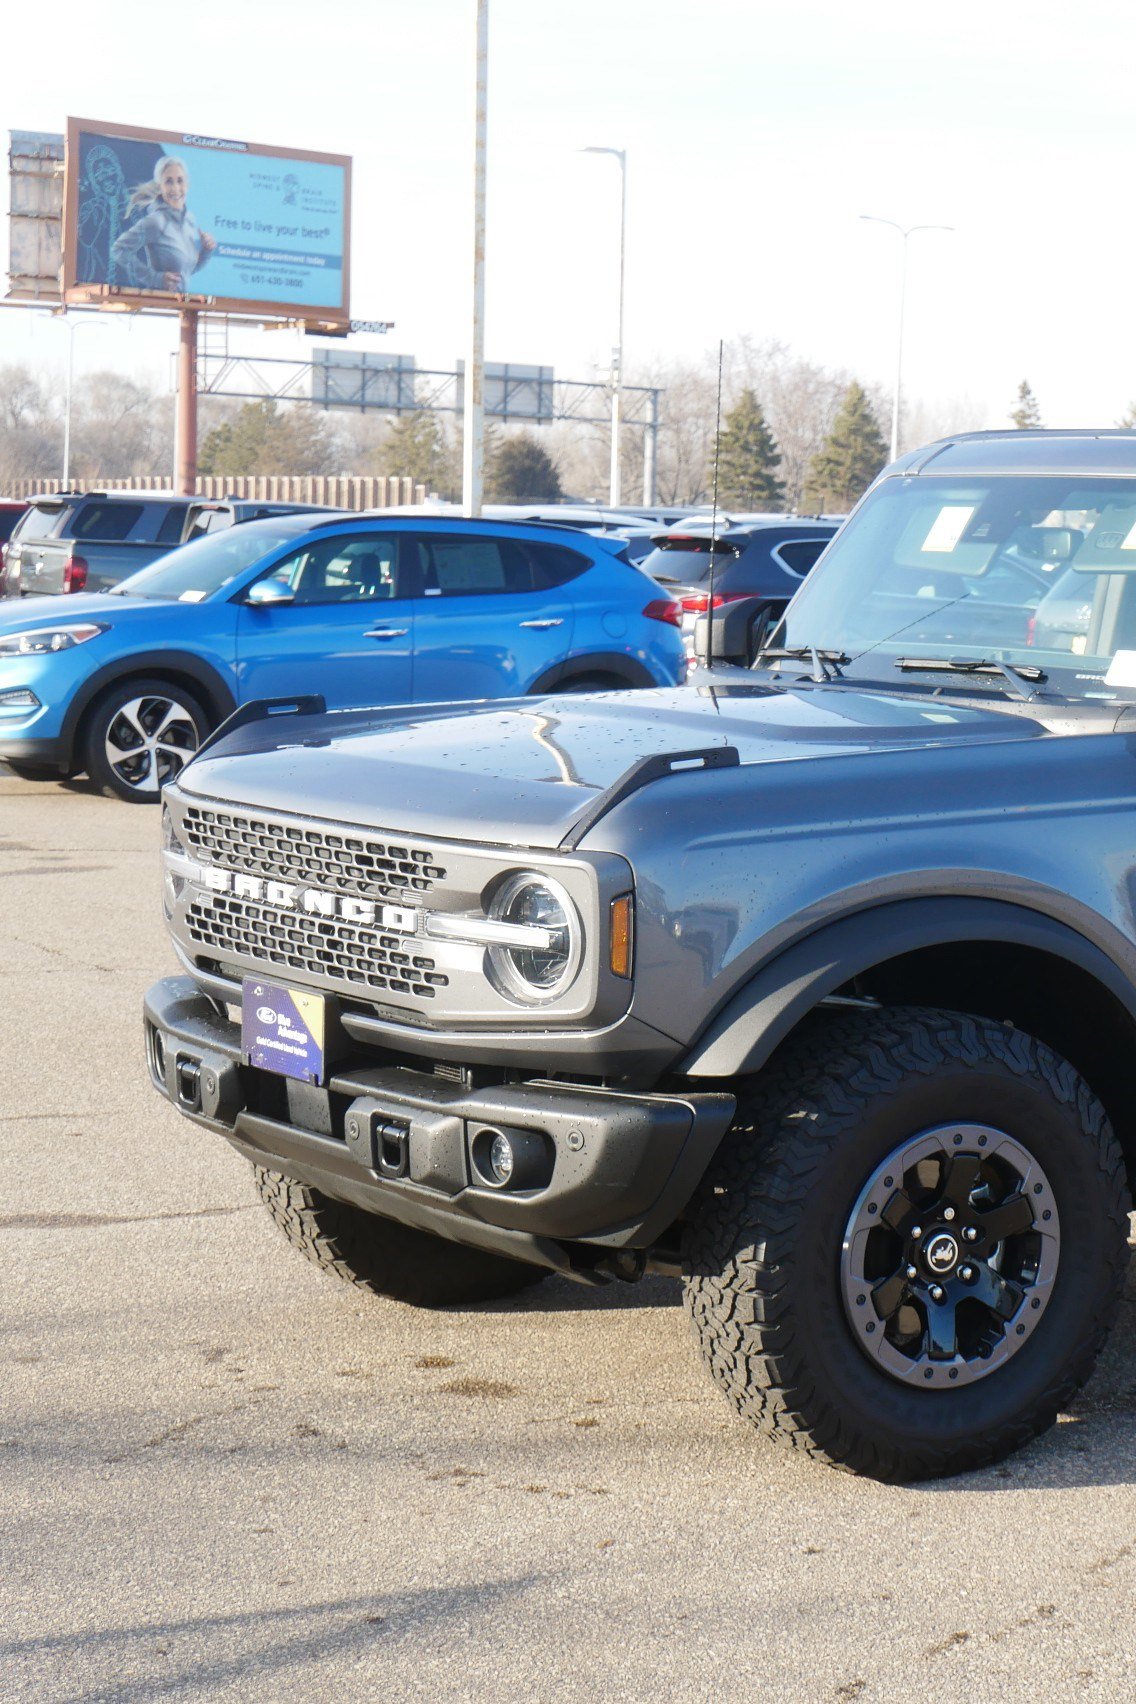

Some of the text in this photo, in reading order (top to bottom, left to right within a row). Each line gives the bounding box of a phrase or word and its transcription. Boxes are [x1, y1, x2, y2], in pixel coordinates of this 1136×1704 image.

[214, 215, 238, 229] Free
[241, 220, 252, 230] to
[254, 220, 273, 233] live
[276, 226, 299, 236] your
[219, 246, 326, 266] Schedule an appointment today
[205, 866, 418, 933] BRONCO
[278, 1013, 291, 1027] Blue
[278, 1025, 308, 1045] Advantage
